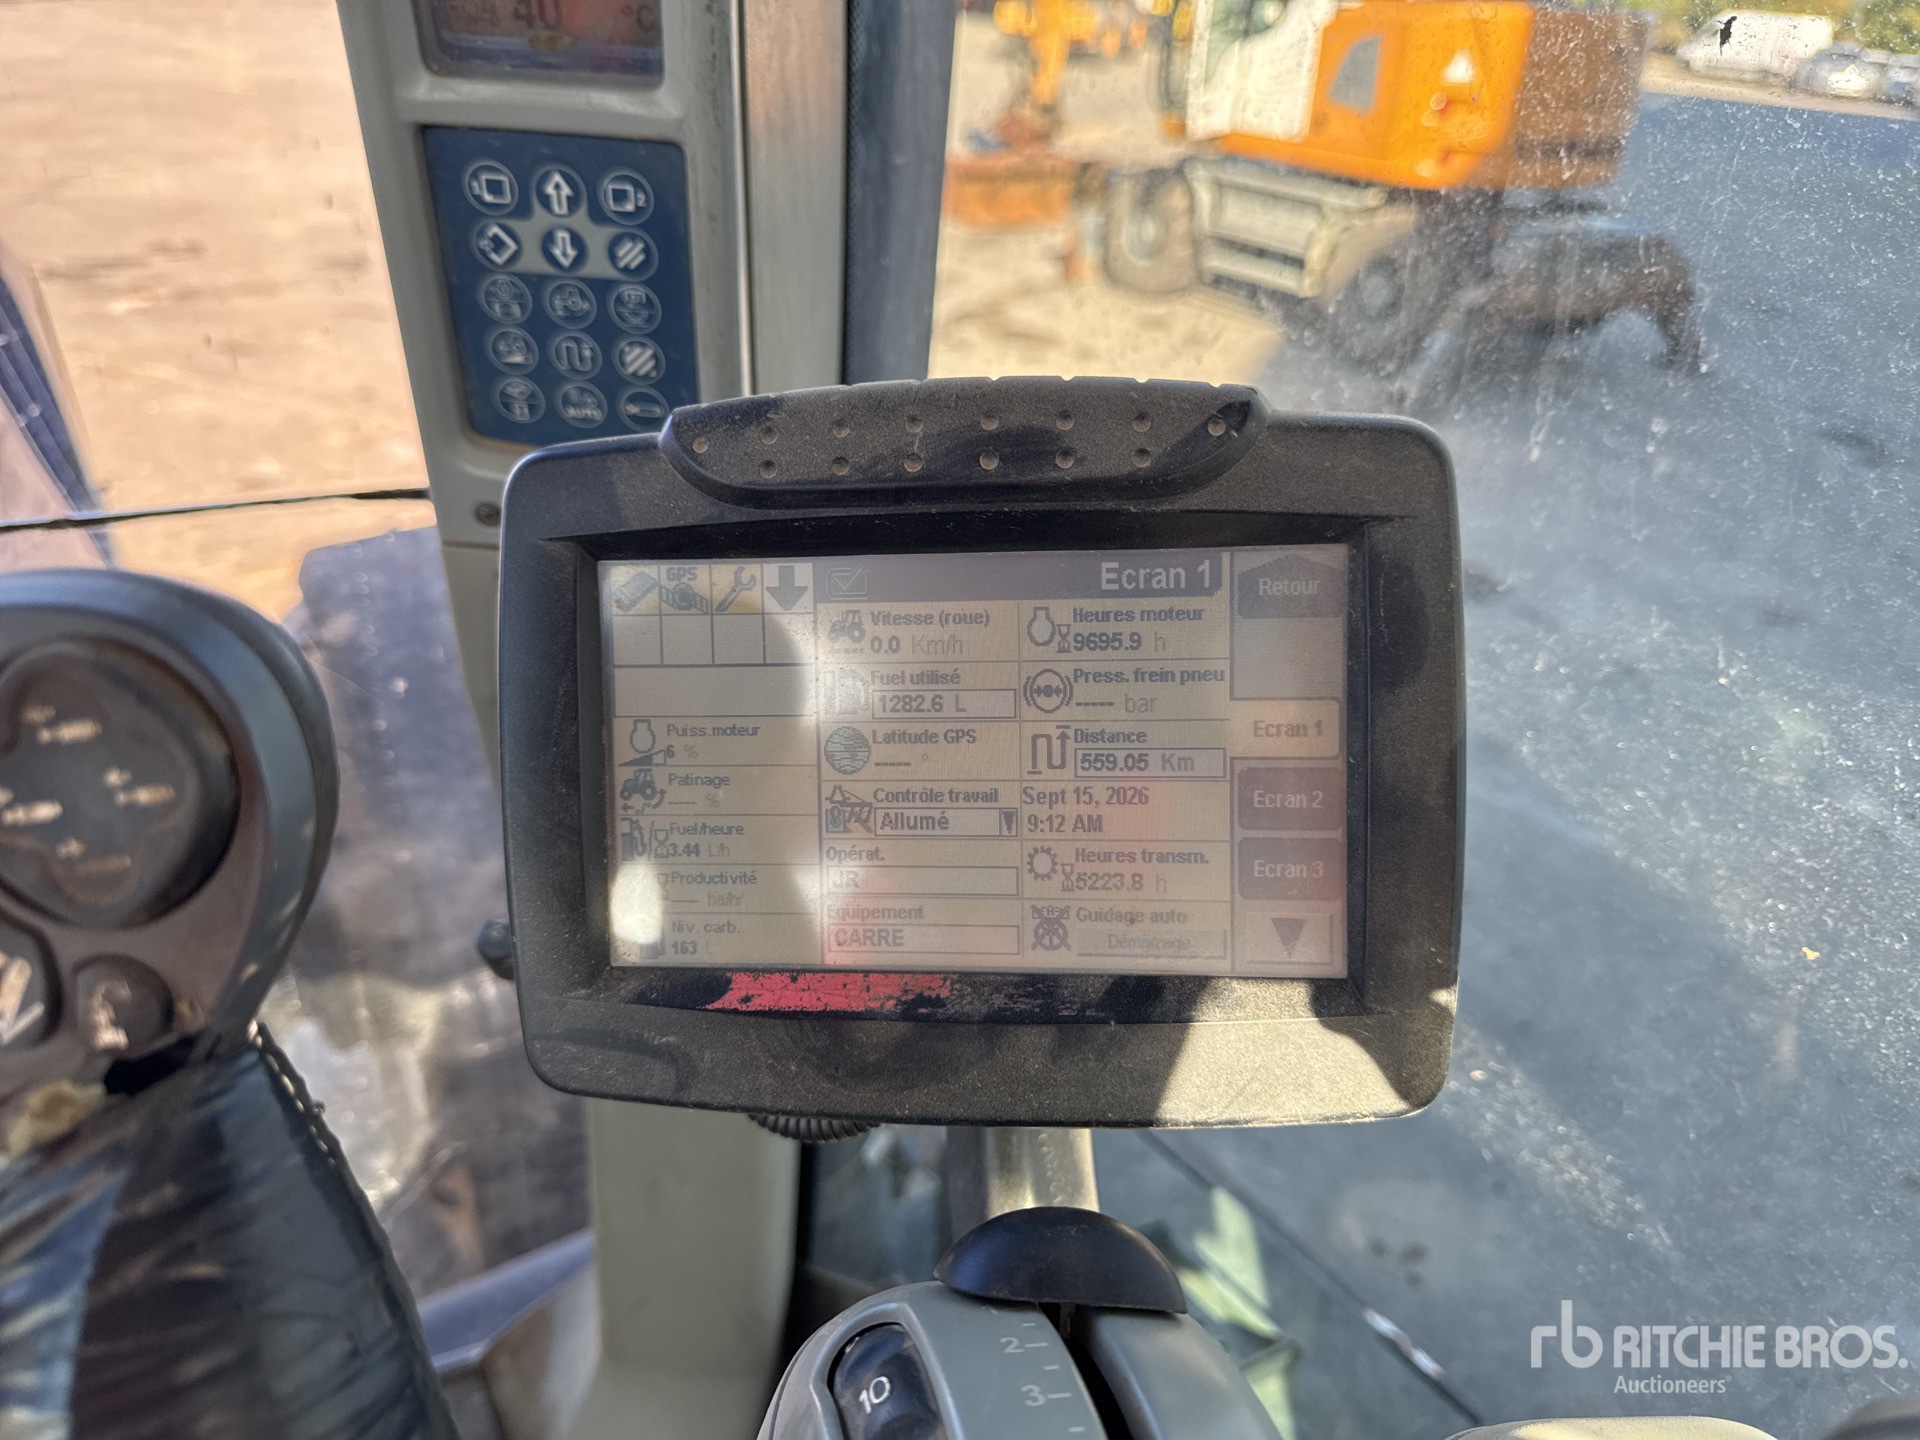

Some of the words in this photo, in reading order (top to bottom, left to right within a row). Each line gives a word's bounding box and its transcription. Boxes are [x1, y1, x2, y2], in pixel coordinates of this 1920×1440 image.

[666, 567, 698, 581] GPS
[1100, 561, 1186, 590] Ecran
[1197, 559, 1210, 588] 1
[1258, 578, 1320, 596] Retour
[870, 610, 934, 626] Vitesse
[939, 609, 990, 628] (roue)
[1073, 608, 1135, 623] Heures
[1140, 608, 1204, 622] moteur
[870, 635, 900, 654] 0.0
[912, 635, 963, 655] Km/h
[1073, 632, 1142, 651] 9695.9
[1154, 632, 1165, 651] h
[871, 671, 905, 685] Fuel
[910, 668, 961, 685] utilisé
[1073, 668, 1129, 684] Press.
[1133, 668, 1175, 682] frein
[1180, 669, 1224, 685] pneu
[879, 694, 943, 713] 1282.6
[954, 694, 967, 713] L
[1124, 692, 1156, 713] bar
[872, 729, 939, 745] Latitude
[944, 729, 976, 744] GPS
[1073, 728, 1147, 744] Distance
[1253, 720, 1308, 737] Ecran
[1313, 719, 1323, 737] 1
[667, 745, 675, 759] 6
[1080, 753, 1149, 772] 559.05
[1161, 753, 1195, 772] Km
[668, 773, 731, 789] Patinage
[874, 786, 944, 803] Contrôle
[948, 788, 999, 803] travail
[1023, 786, 1067, 809] Sept
[1073, 786, 1100, 808] 15,
[1105, 786, 1150, 805] 2026
[1253, 790, 1307, 808] Ecran
[1311, 790, 1323, 808] 2
[670, 823, 745, 836] Fuel/heure
[880, 811, 950, 831] Allumé
[1027, 814, 1066, 833] 9:12
[1072, 814, 1104, 833] AM
[668, 843, 700, 857] 3.44
[826, 845, 885, 863] Opérat.
[1075, 848, 1136, 863] Heures
[1141, 849, 1210, 864] transm.
[671, 870, 757, 885] Productivité
[1253, 860, 1307, 878] Ecran
[1311, 860, 1323, 878] 3
[1075, 872, 1143, 891] 5223.8
[1076, 907, 1145, 926] Guidage
[1151, 909, 1188, 923] auto
[673, 920, 699, 933] Niv.
[704, 920, 741, 933] carb.
[835, 928, 904, 947] CARRE
[671, 941, 698, 955] 163
[1000, 1337, 1024, 1354] 2
[859, 1376, 891, 1415] 10
[1021, 1384, 1045, 1407] 3
